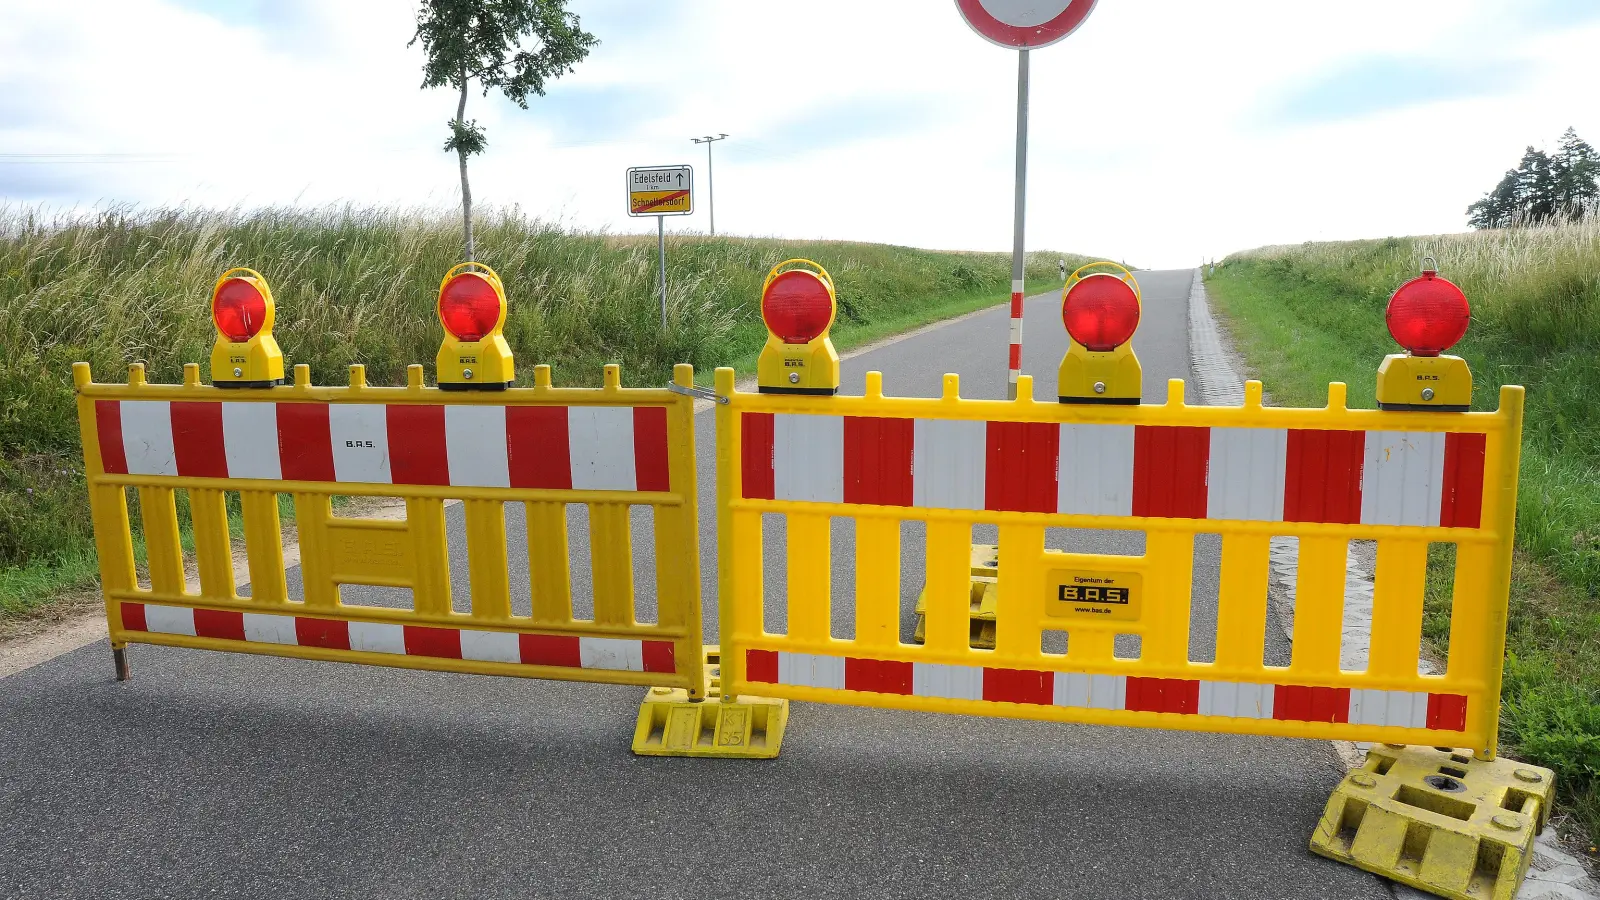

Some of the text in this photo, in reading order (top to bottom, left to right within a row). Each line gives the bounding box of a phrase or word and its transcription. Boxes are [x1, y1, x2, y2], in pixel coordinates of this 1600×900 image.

[634, 172, 671, 184] Edelsfeld
[345, 440, 376, 448] B.A.S.
[1074, 576, 1103, 584] Eigentum
[1063, 586, 1126, 603] B.A.S.
[1074, 606, 1112, 614] www.bas.de
[723, 731, 743, 746] 35
